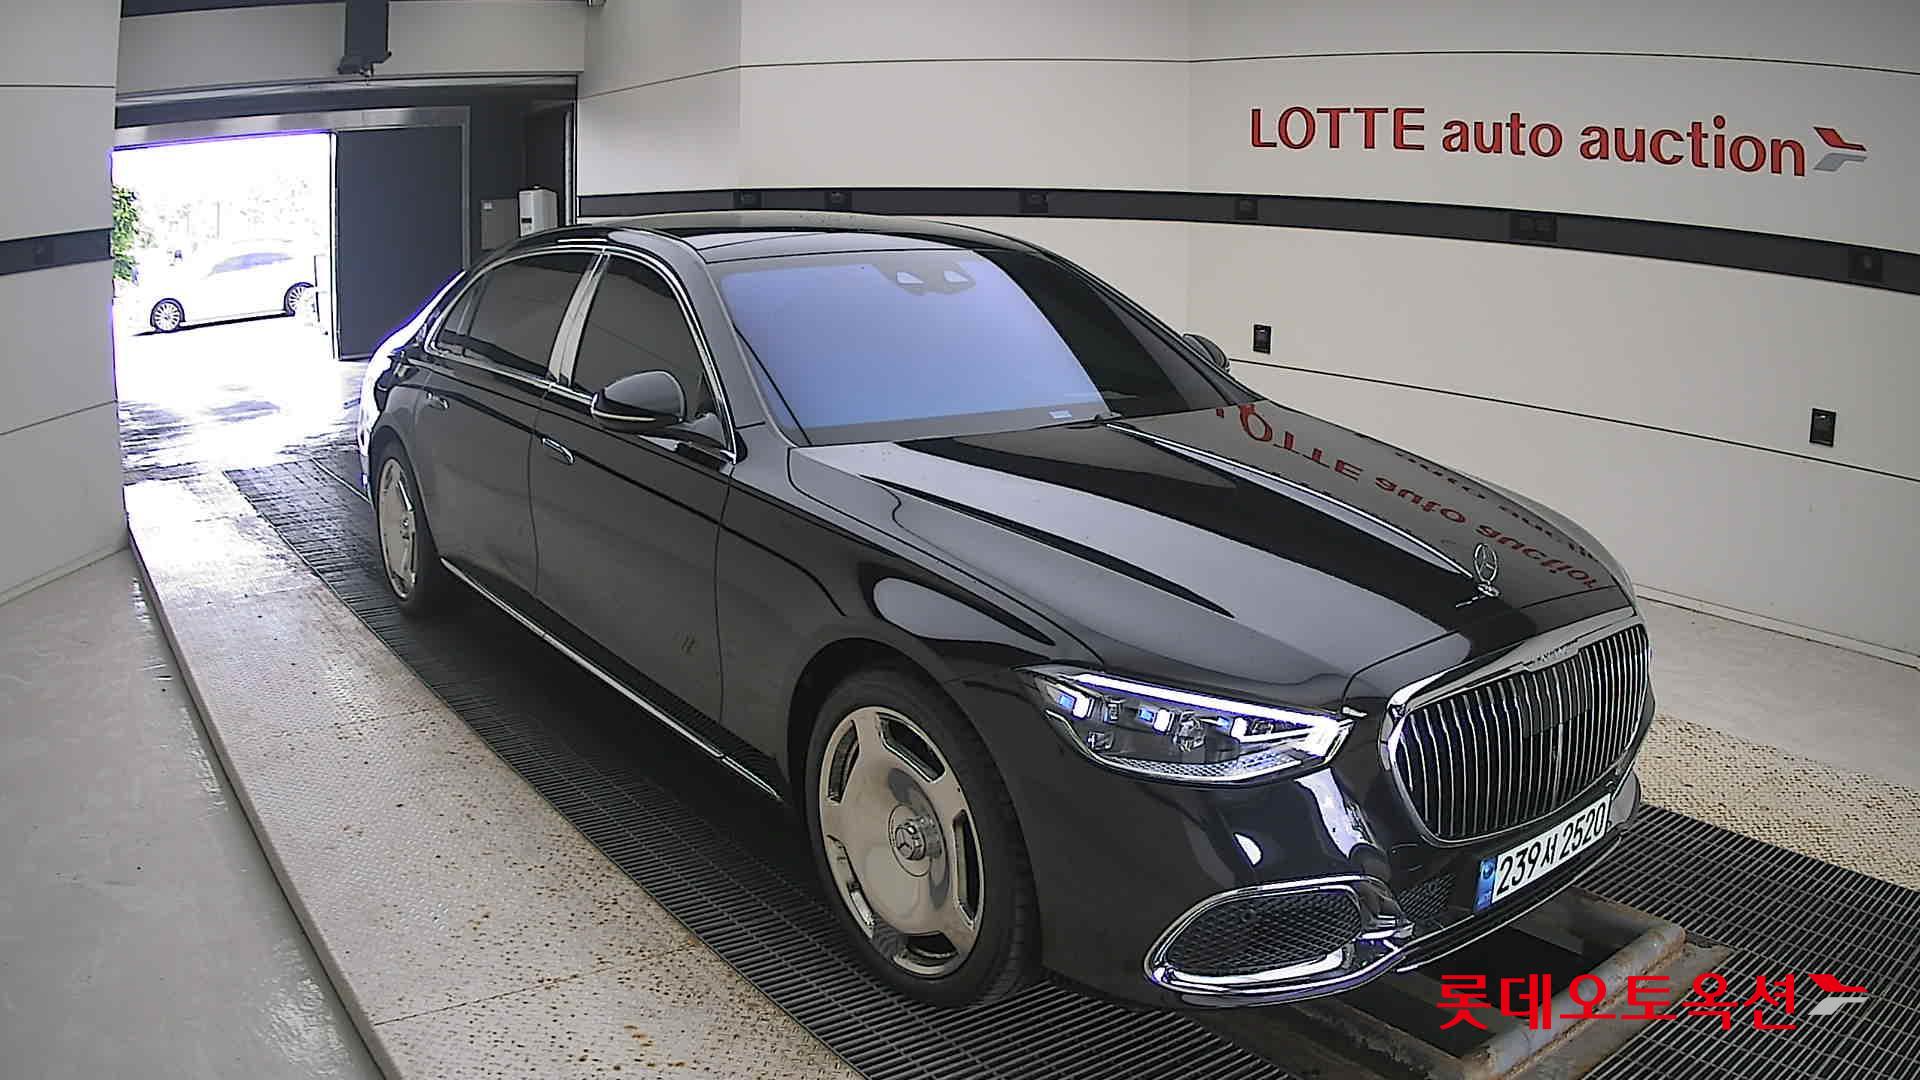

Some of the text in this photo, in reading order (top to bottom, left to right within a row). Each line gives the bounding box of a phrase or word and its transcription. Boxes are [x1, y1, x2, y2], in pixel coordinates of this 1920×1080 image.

[1250, 106, 1806, 177] LOTTE auto auction
